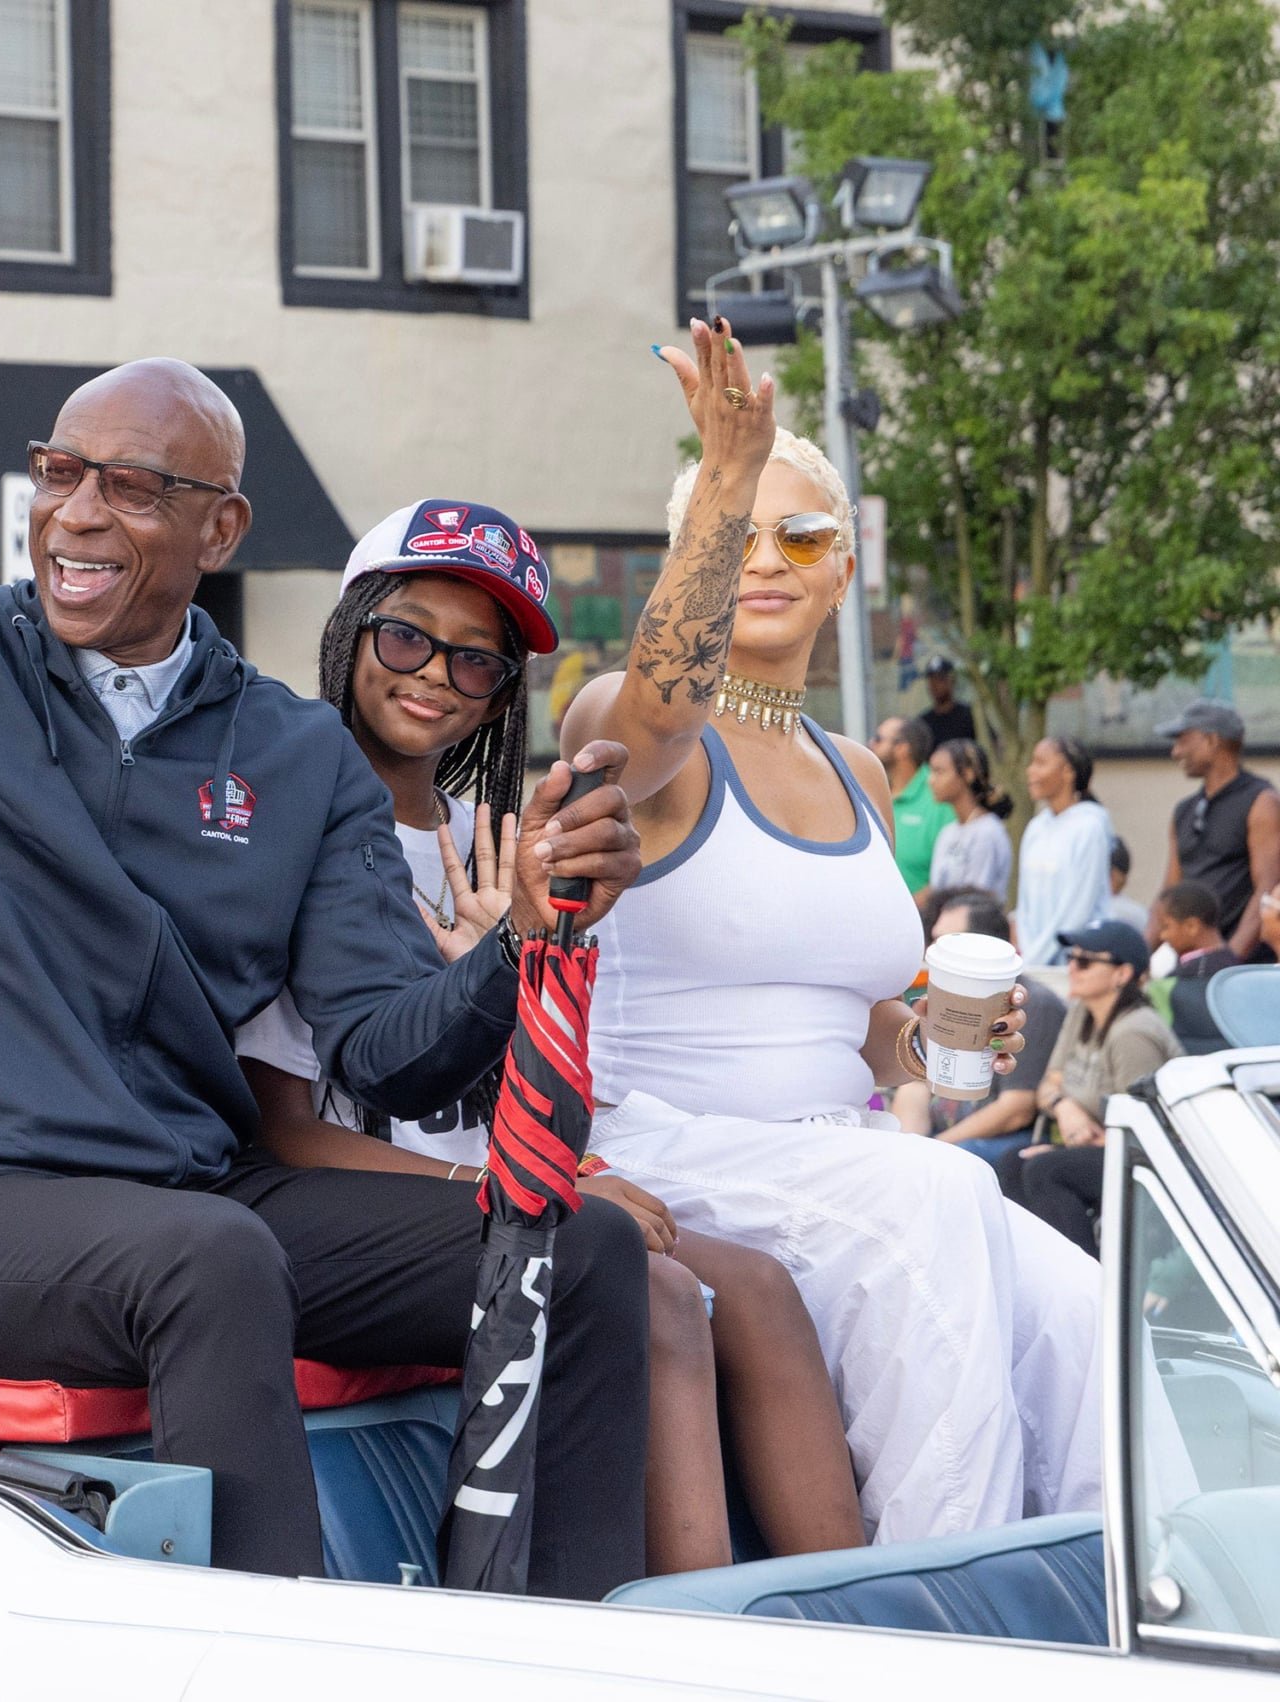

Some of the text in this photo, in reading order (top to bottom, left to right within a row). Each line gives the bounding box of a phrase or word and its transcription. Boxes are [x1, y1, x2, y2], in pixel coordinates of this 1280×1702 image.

[230, 814, 249, 827] FAME
[201, 829, 249, 844] CANTON, OHIO
